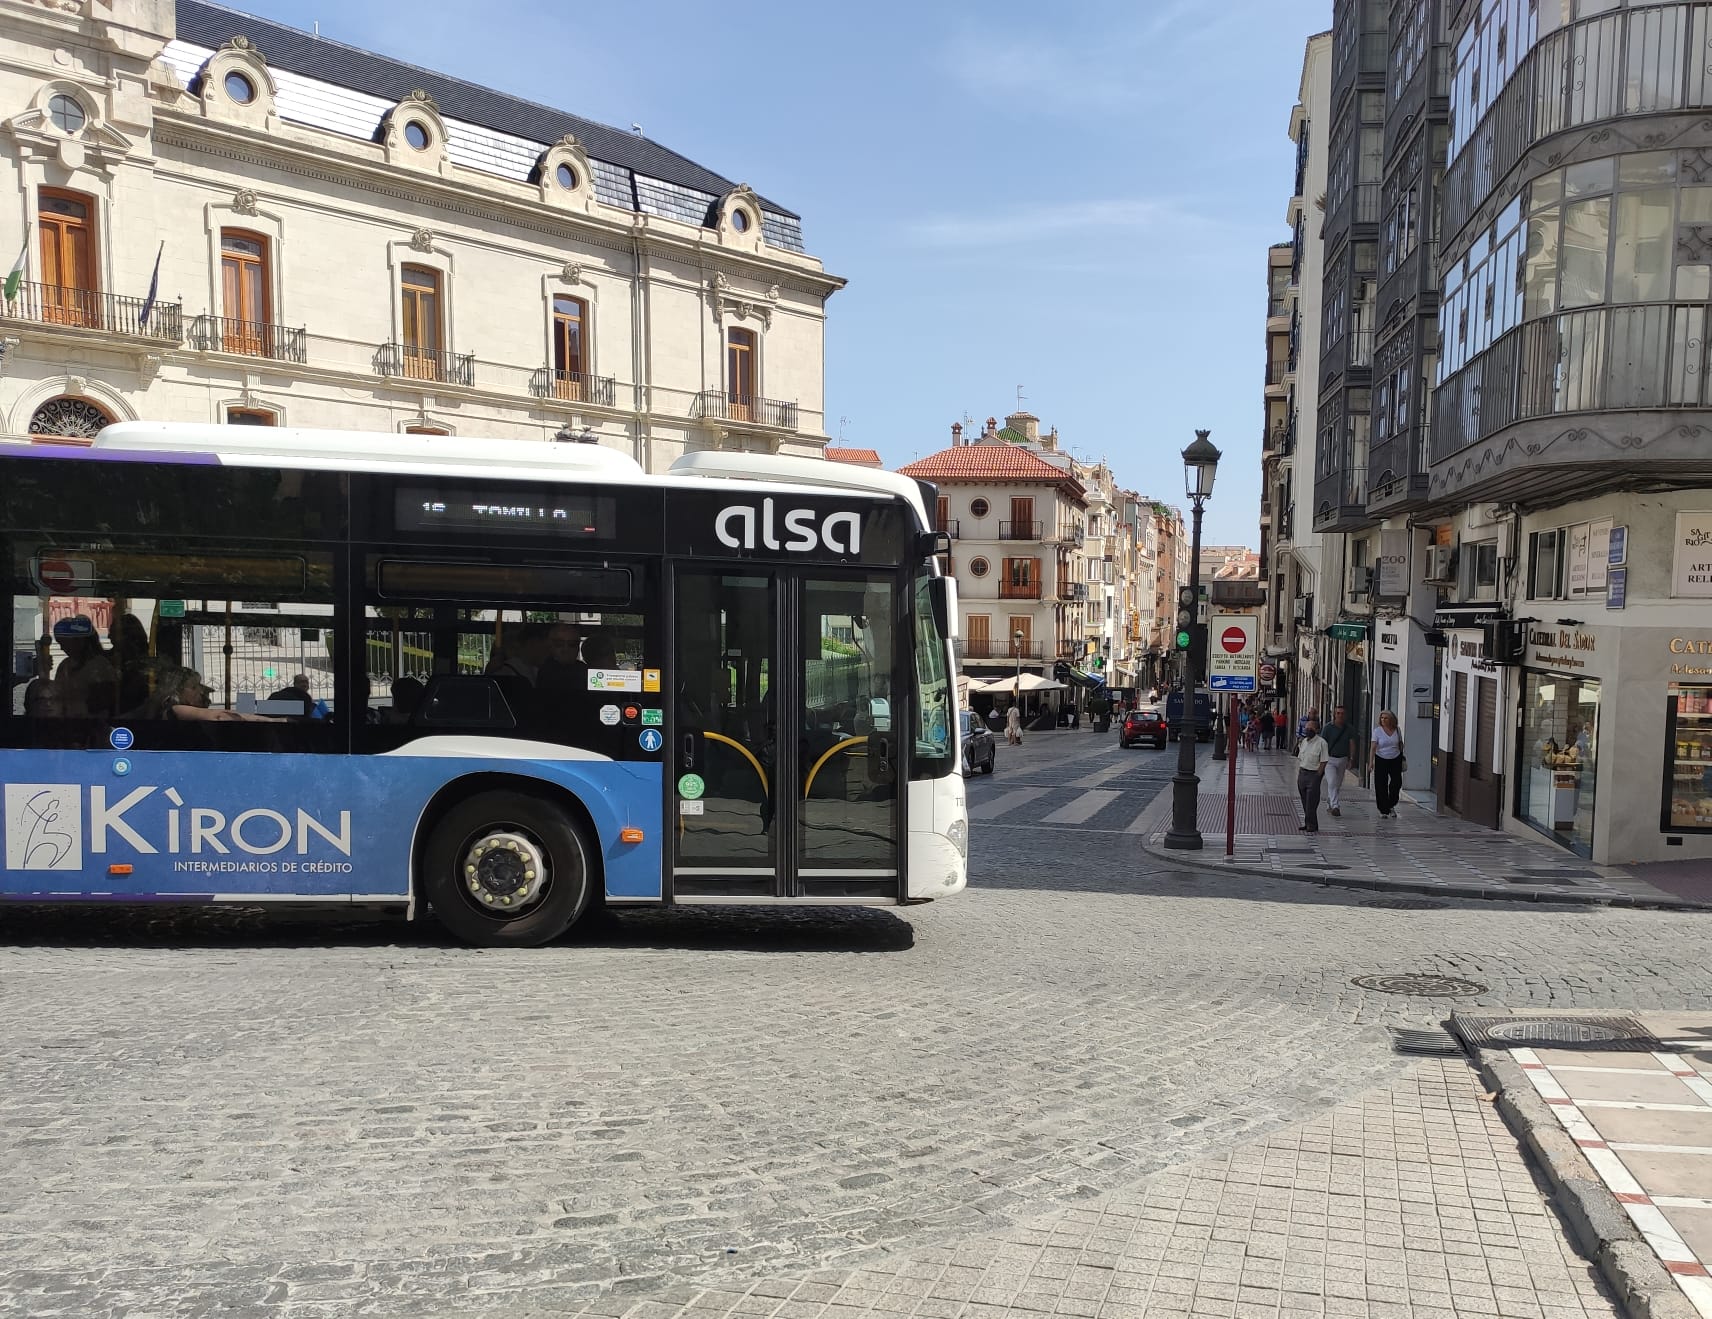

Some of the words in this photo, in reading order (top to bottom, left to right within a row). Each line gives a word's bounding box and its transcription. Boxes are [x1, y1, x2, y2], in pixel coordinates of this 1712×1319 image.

[715, 497, 861, 555] alsa
[1382, 556, 1406, 565] ZOO
[174, 861, 278, 873] INTERMEDIARIOS
[281, 863, 298, 873] DE
[301, 860, 353, 873] CRÉDITO
